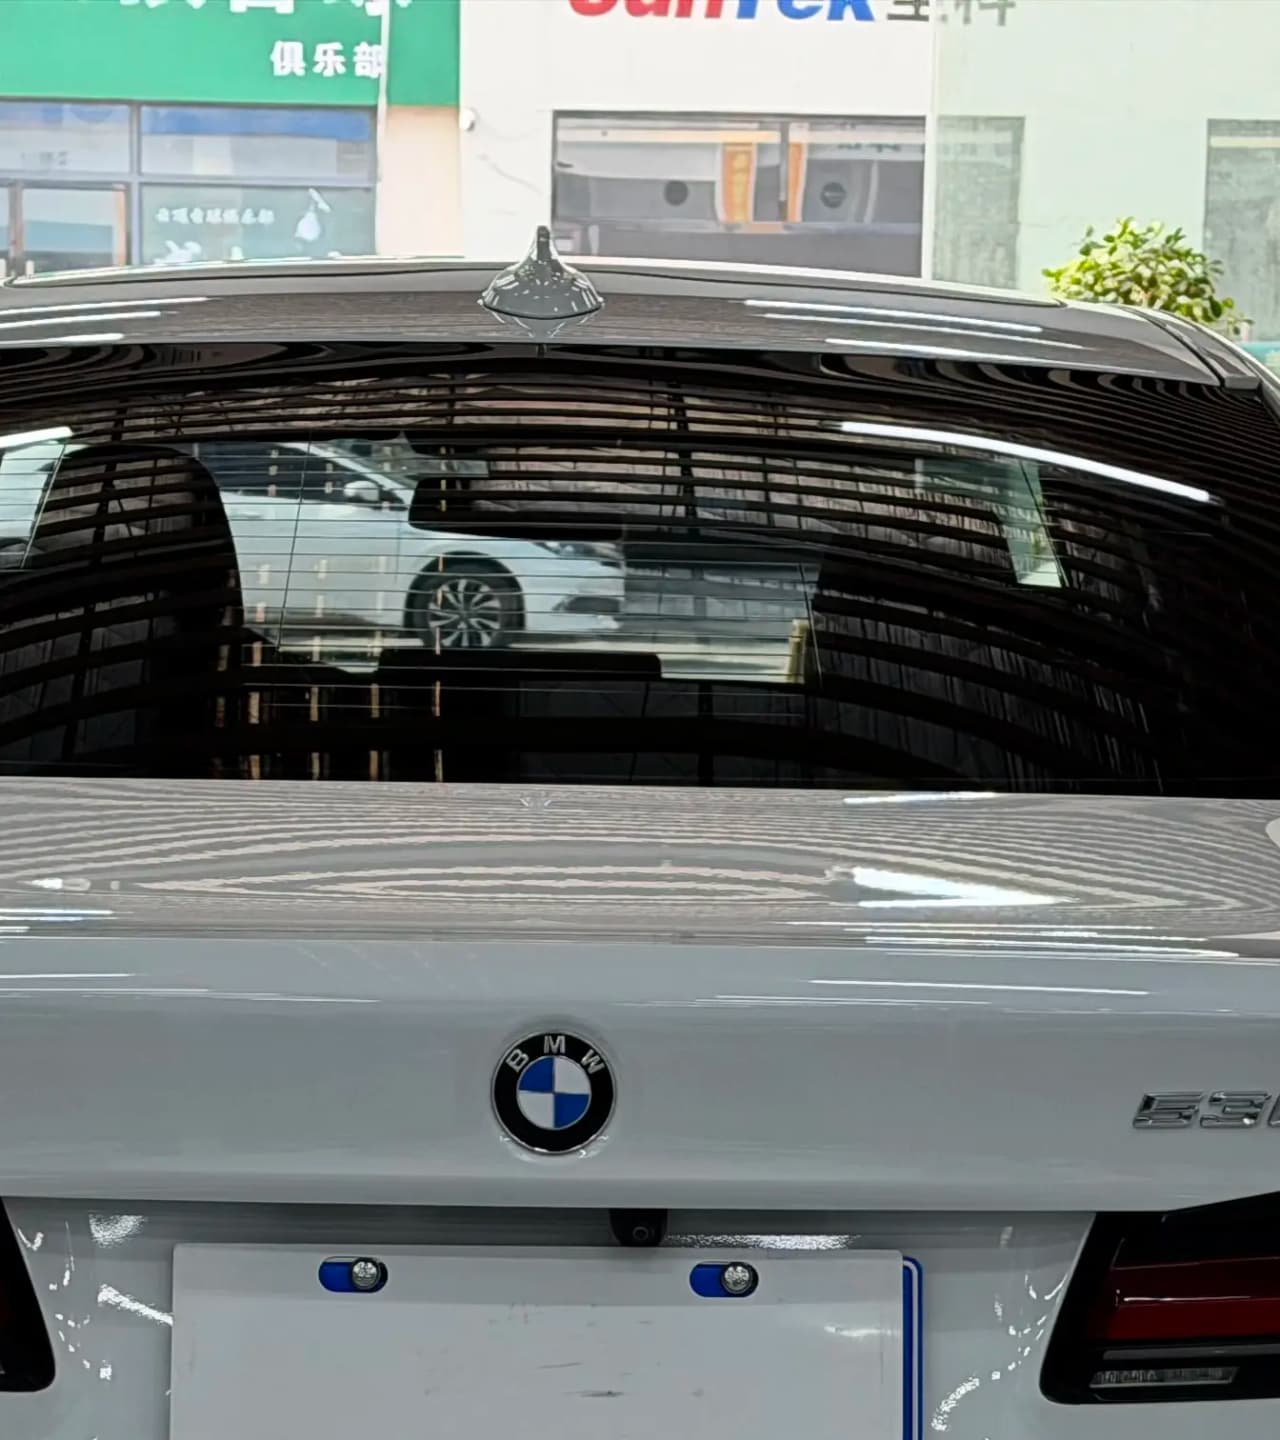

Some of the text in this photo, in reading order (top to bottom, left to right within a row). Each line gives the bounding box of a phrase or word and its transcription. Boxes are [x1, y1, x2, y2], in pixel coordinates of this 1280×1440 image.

[271, 41, 385, 77] 俱乐部
[505, 1035, 605, 1074] BMW
